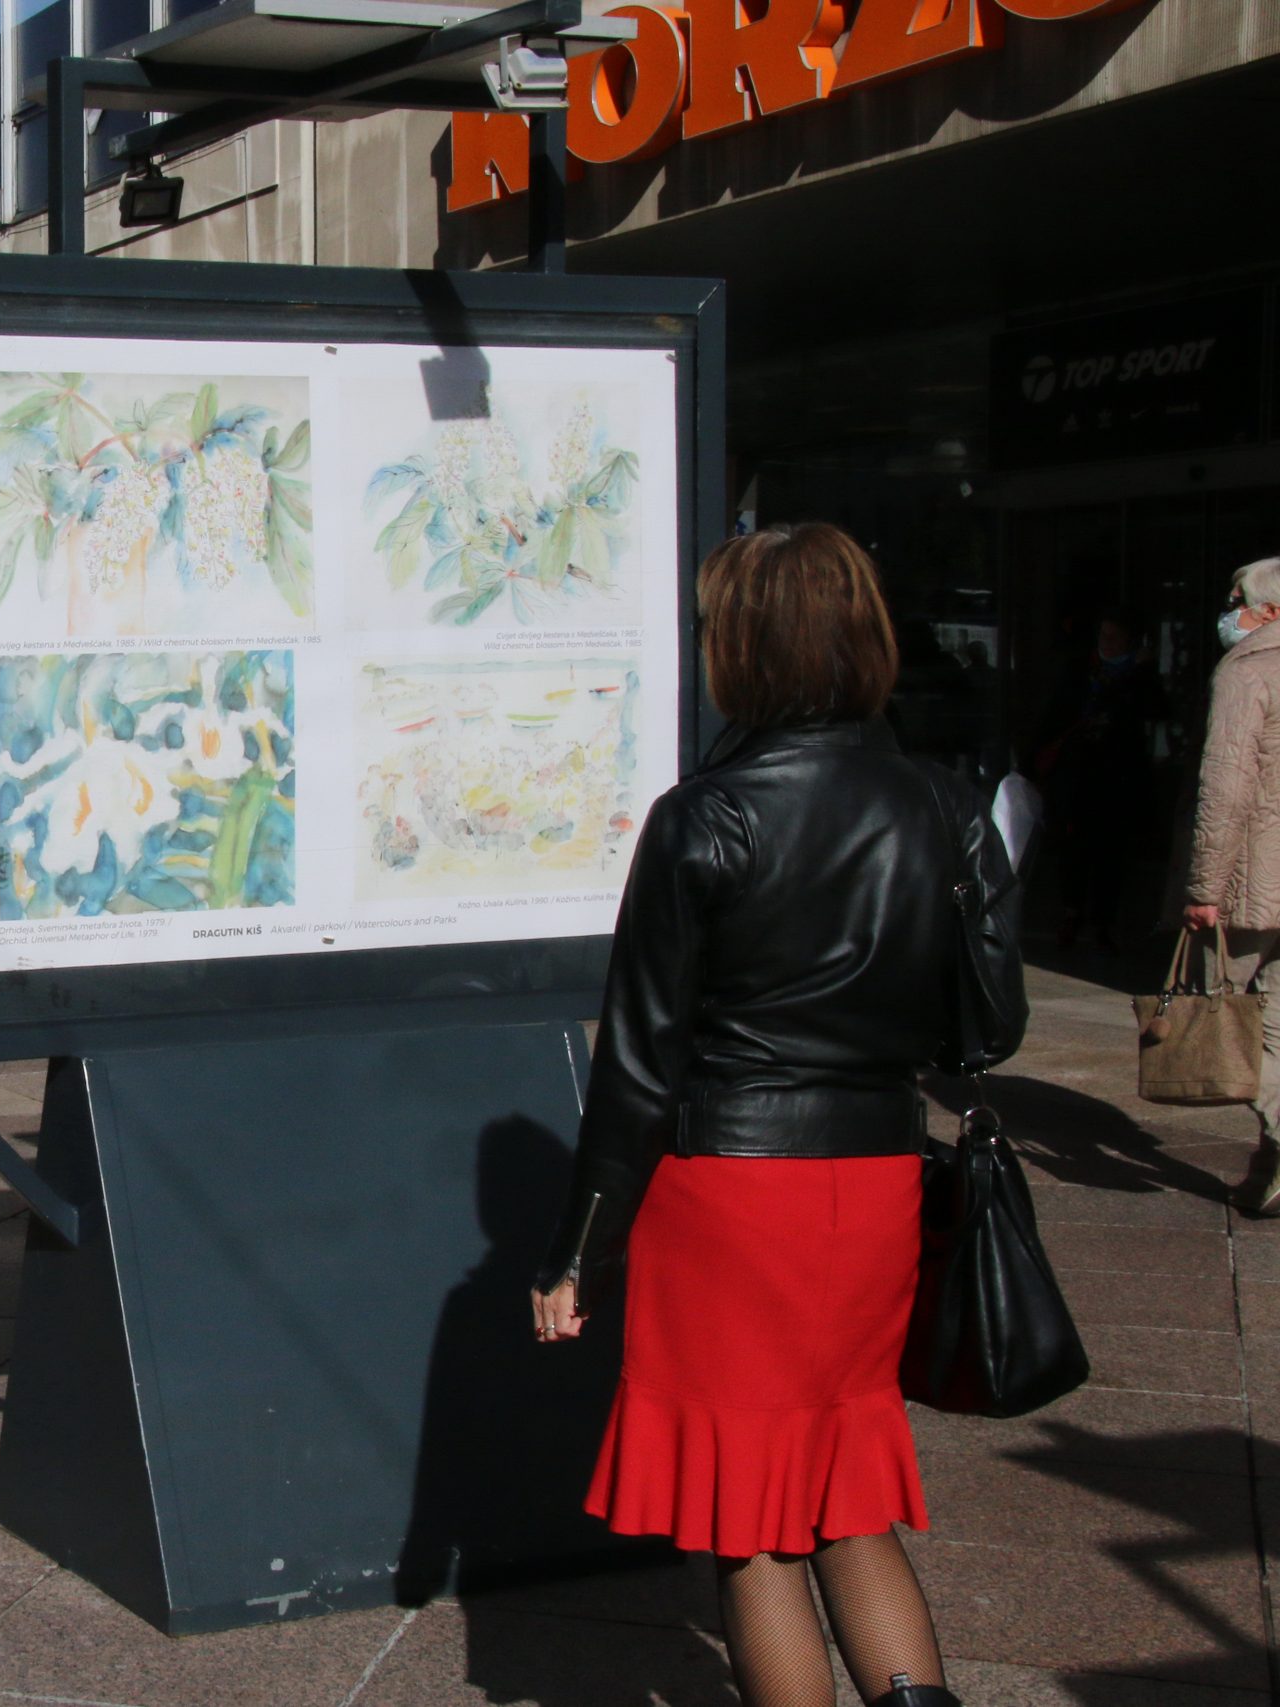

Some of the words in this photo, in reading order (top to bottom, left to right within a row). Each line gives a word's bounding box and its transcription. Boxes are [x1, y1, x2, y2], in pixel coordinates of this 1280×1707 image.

[447, 0, 1116, 213] KOR
[1061, 355, 1116, 391] TOP
[1117, 337, 1217, 382] SPORT
[144, 637, 162, 647] Wild
[163, 637, 199, 647] chestnut
[200, 637, 233, 646] blossom
[235, 636, 254, 645] from
[79, 921, 117, 931] metafora
[192, 927, 243, 939] DRAGUTIN
[246, 923, 263, 935] KIŠ
[270, 923, 306, 934] Akvareli
[313, 921, 347, 934] parkovi
[354, 918, 413, 929] Watercolours
[413, 916, 432, 926] and
[433, 914, 457, 924] Parks
[31, 935, 67, 944] Universal
[69, 932, 110, 943] Metaphor
[111, 931, 120, 940] of
